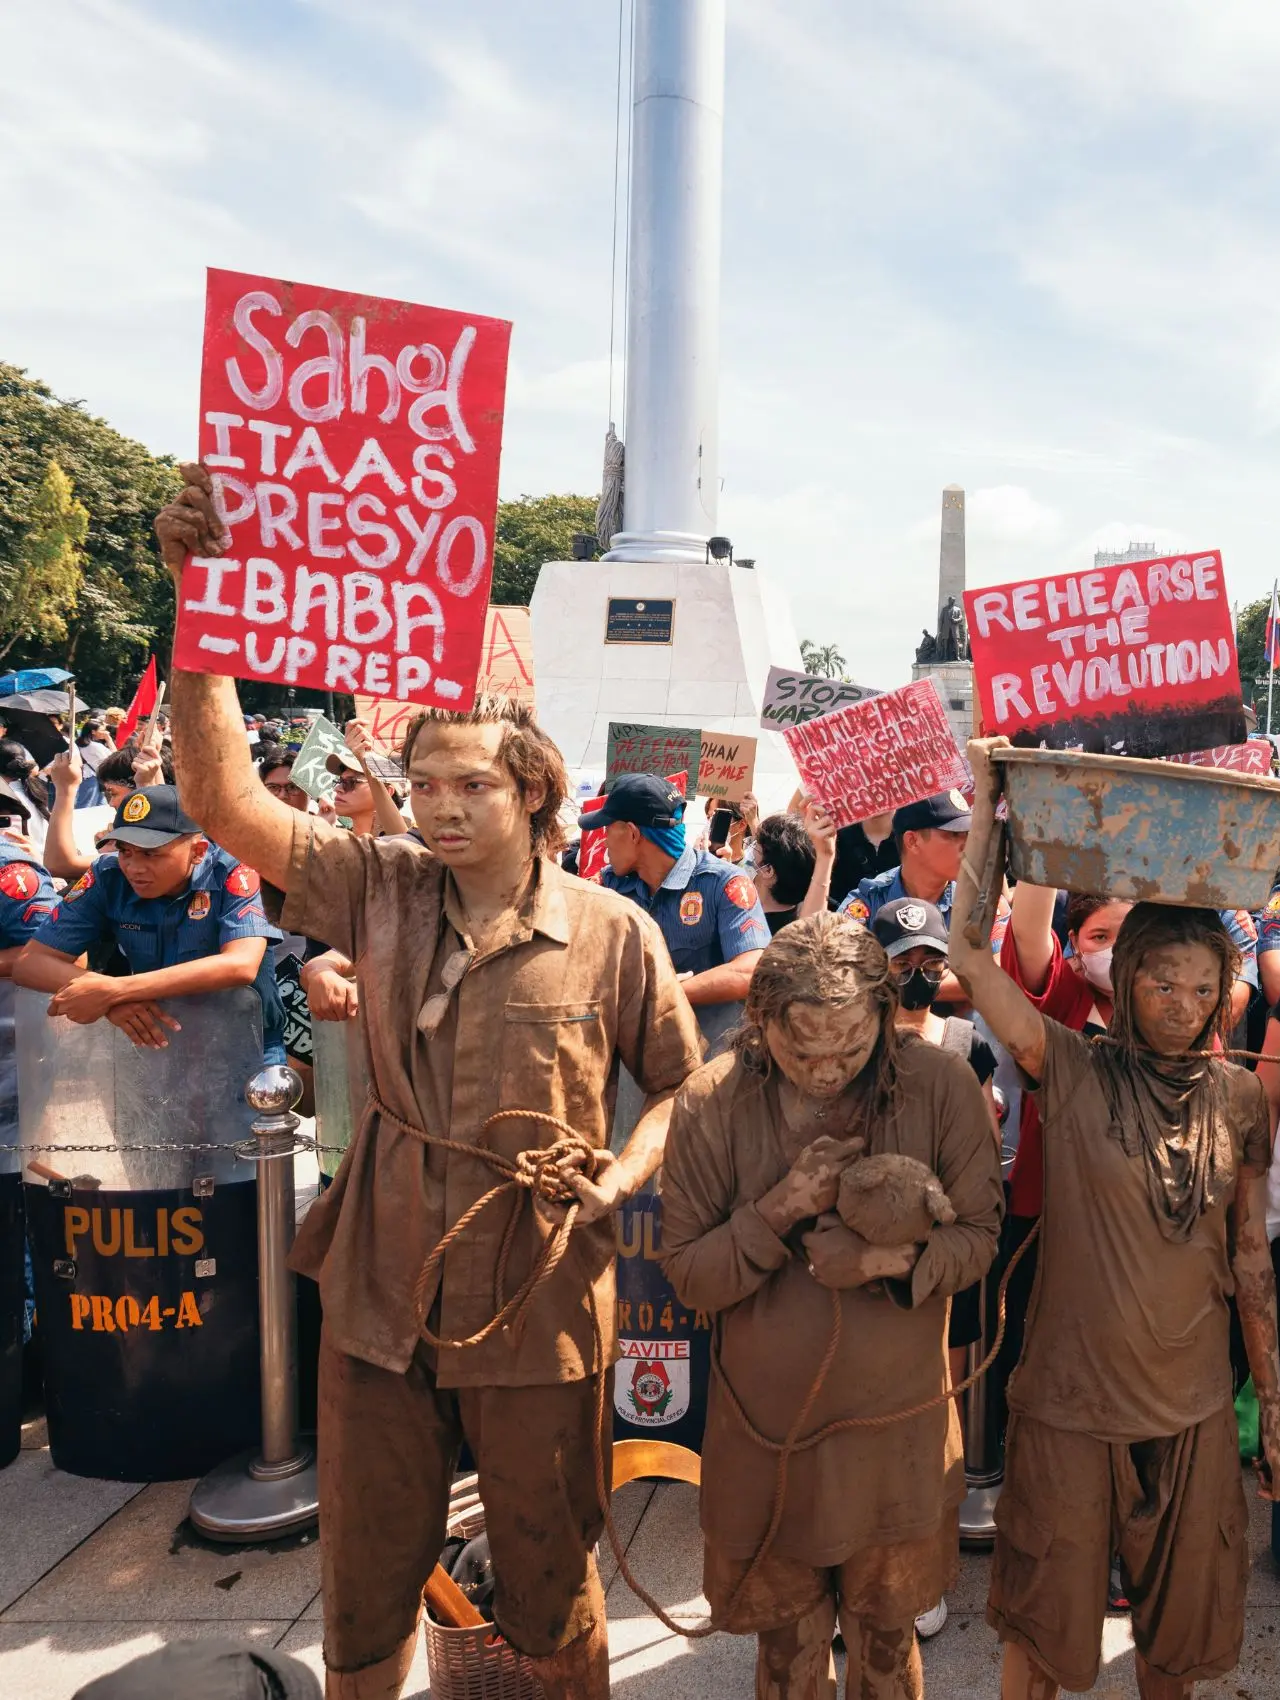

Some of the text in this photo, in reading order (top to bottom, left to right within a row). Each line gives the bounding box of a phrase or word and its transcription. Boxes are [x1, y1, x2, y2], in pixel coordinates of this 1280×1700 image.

[225, 291, 477, 454] Sahod
[204, 412, 458, 510] ITAAS
[210, 472, 486, 598] PRESYO
[185, 557, 446, 663] IBABA
[973, 556, 1219, 638] REHEARSE
[1047, 605, 1150, 659] THE
[776, 677, 862, 707] STOP
[991, 638, 1231, 725] REVOLUTION
[614, 735, 693, 755] DEFEND
[64, 1206, 204, 1257] PULIS
